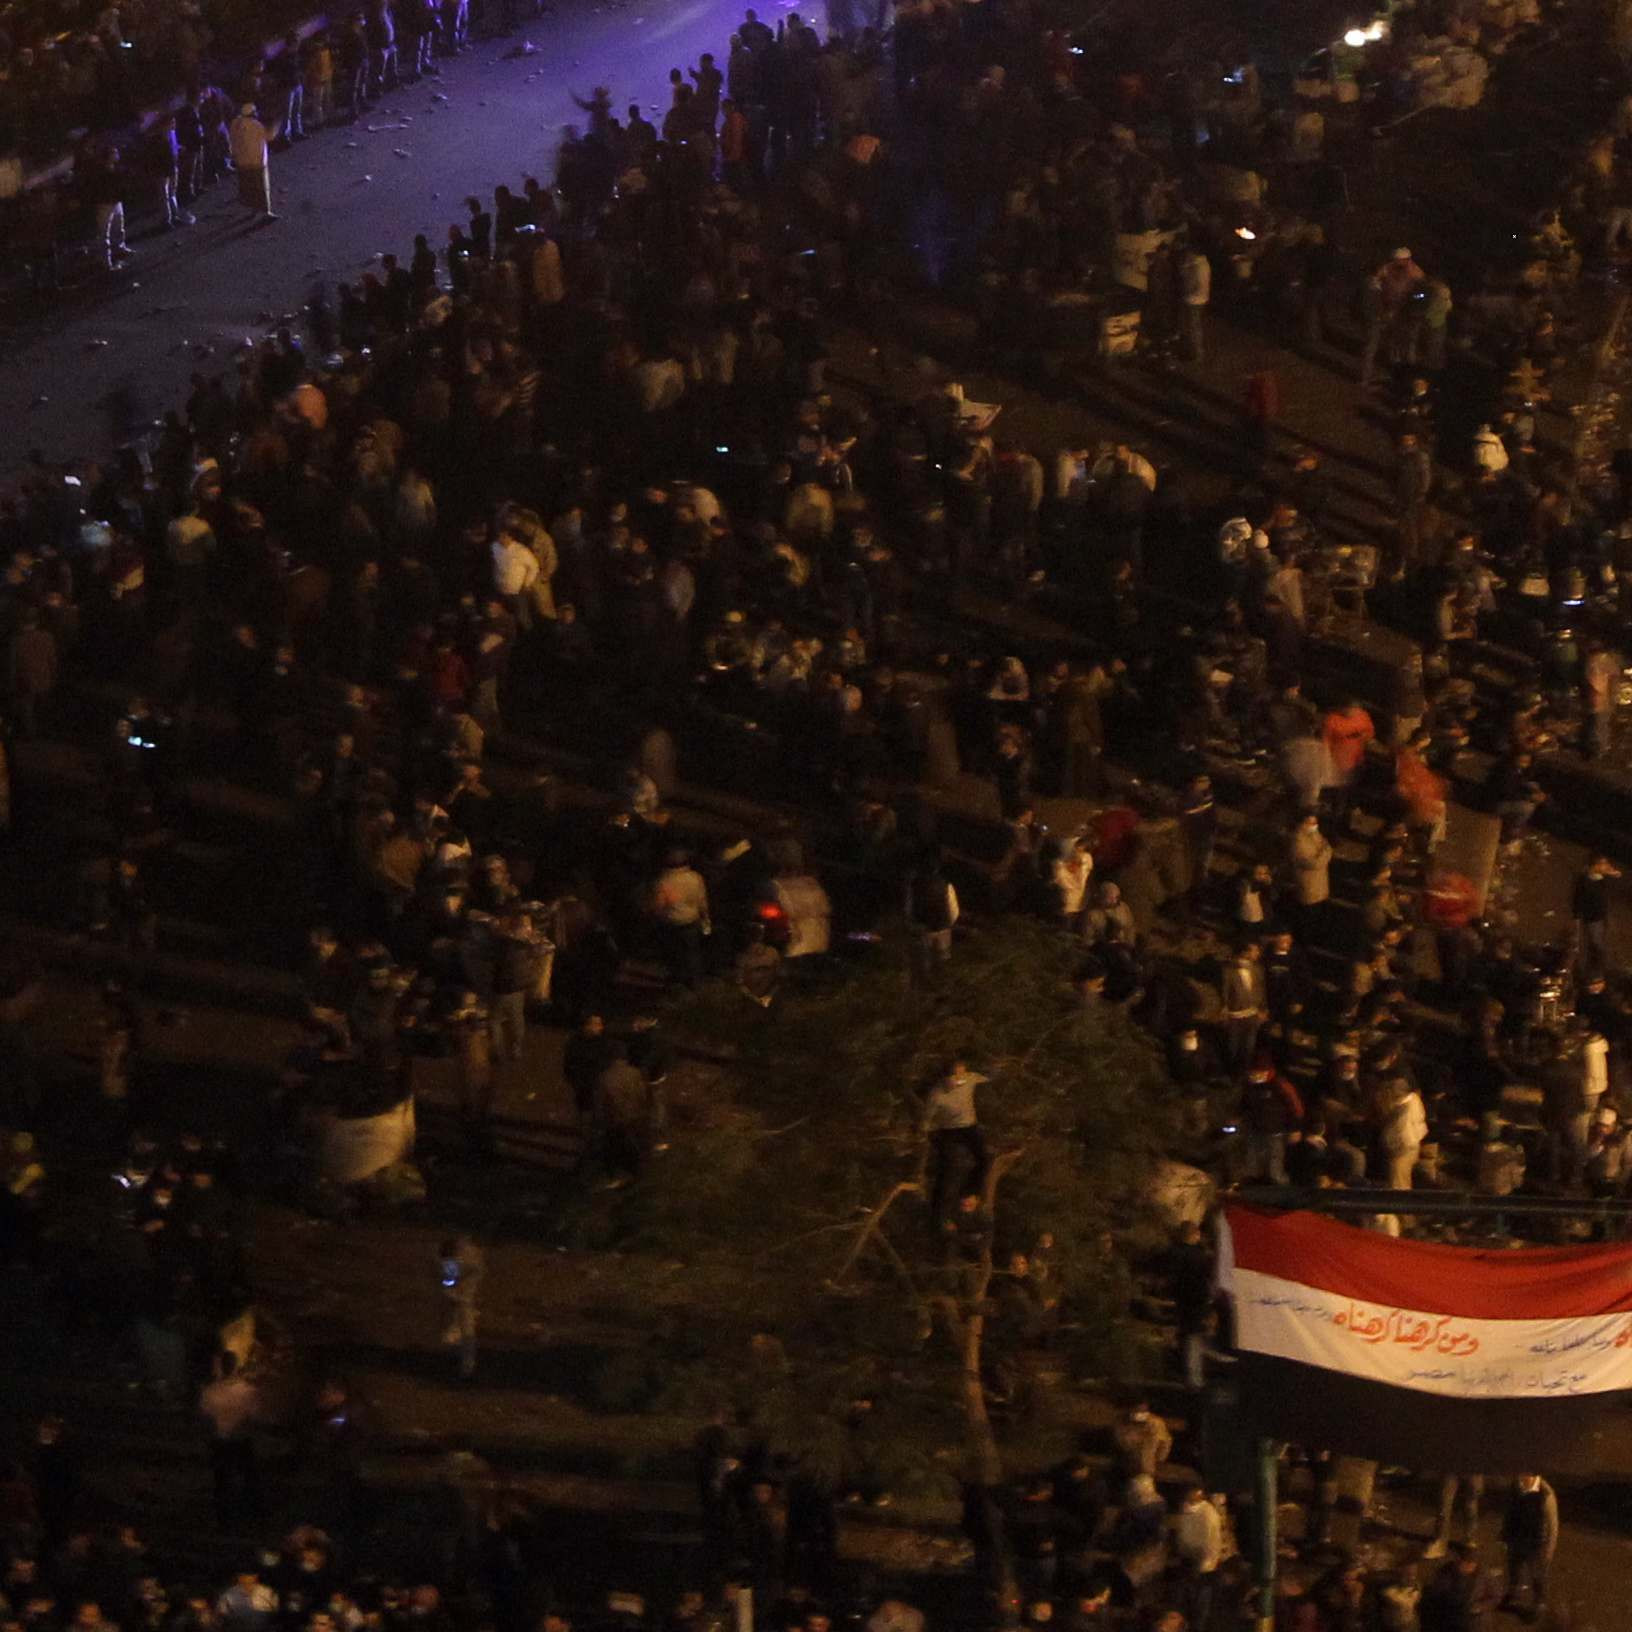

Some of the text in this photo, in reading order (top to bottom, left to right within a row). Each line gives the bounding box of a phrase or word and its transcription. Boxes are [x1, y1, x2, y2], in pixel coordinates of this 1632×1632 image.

[1332, 1302, 1402, 1344] كرهناه
[1394, 1312, 1454, 1352] كرهنا
[1436, 1331, 1480, 1356] ومن
[1569, 1371, 1588, 1394] مع
